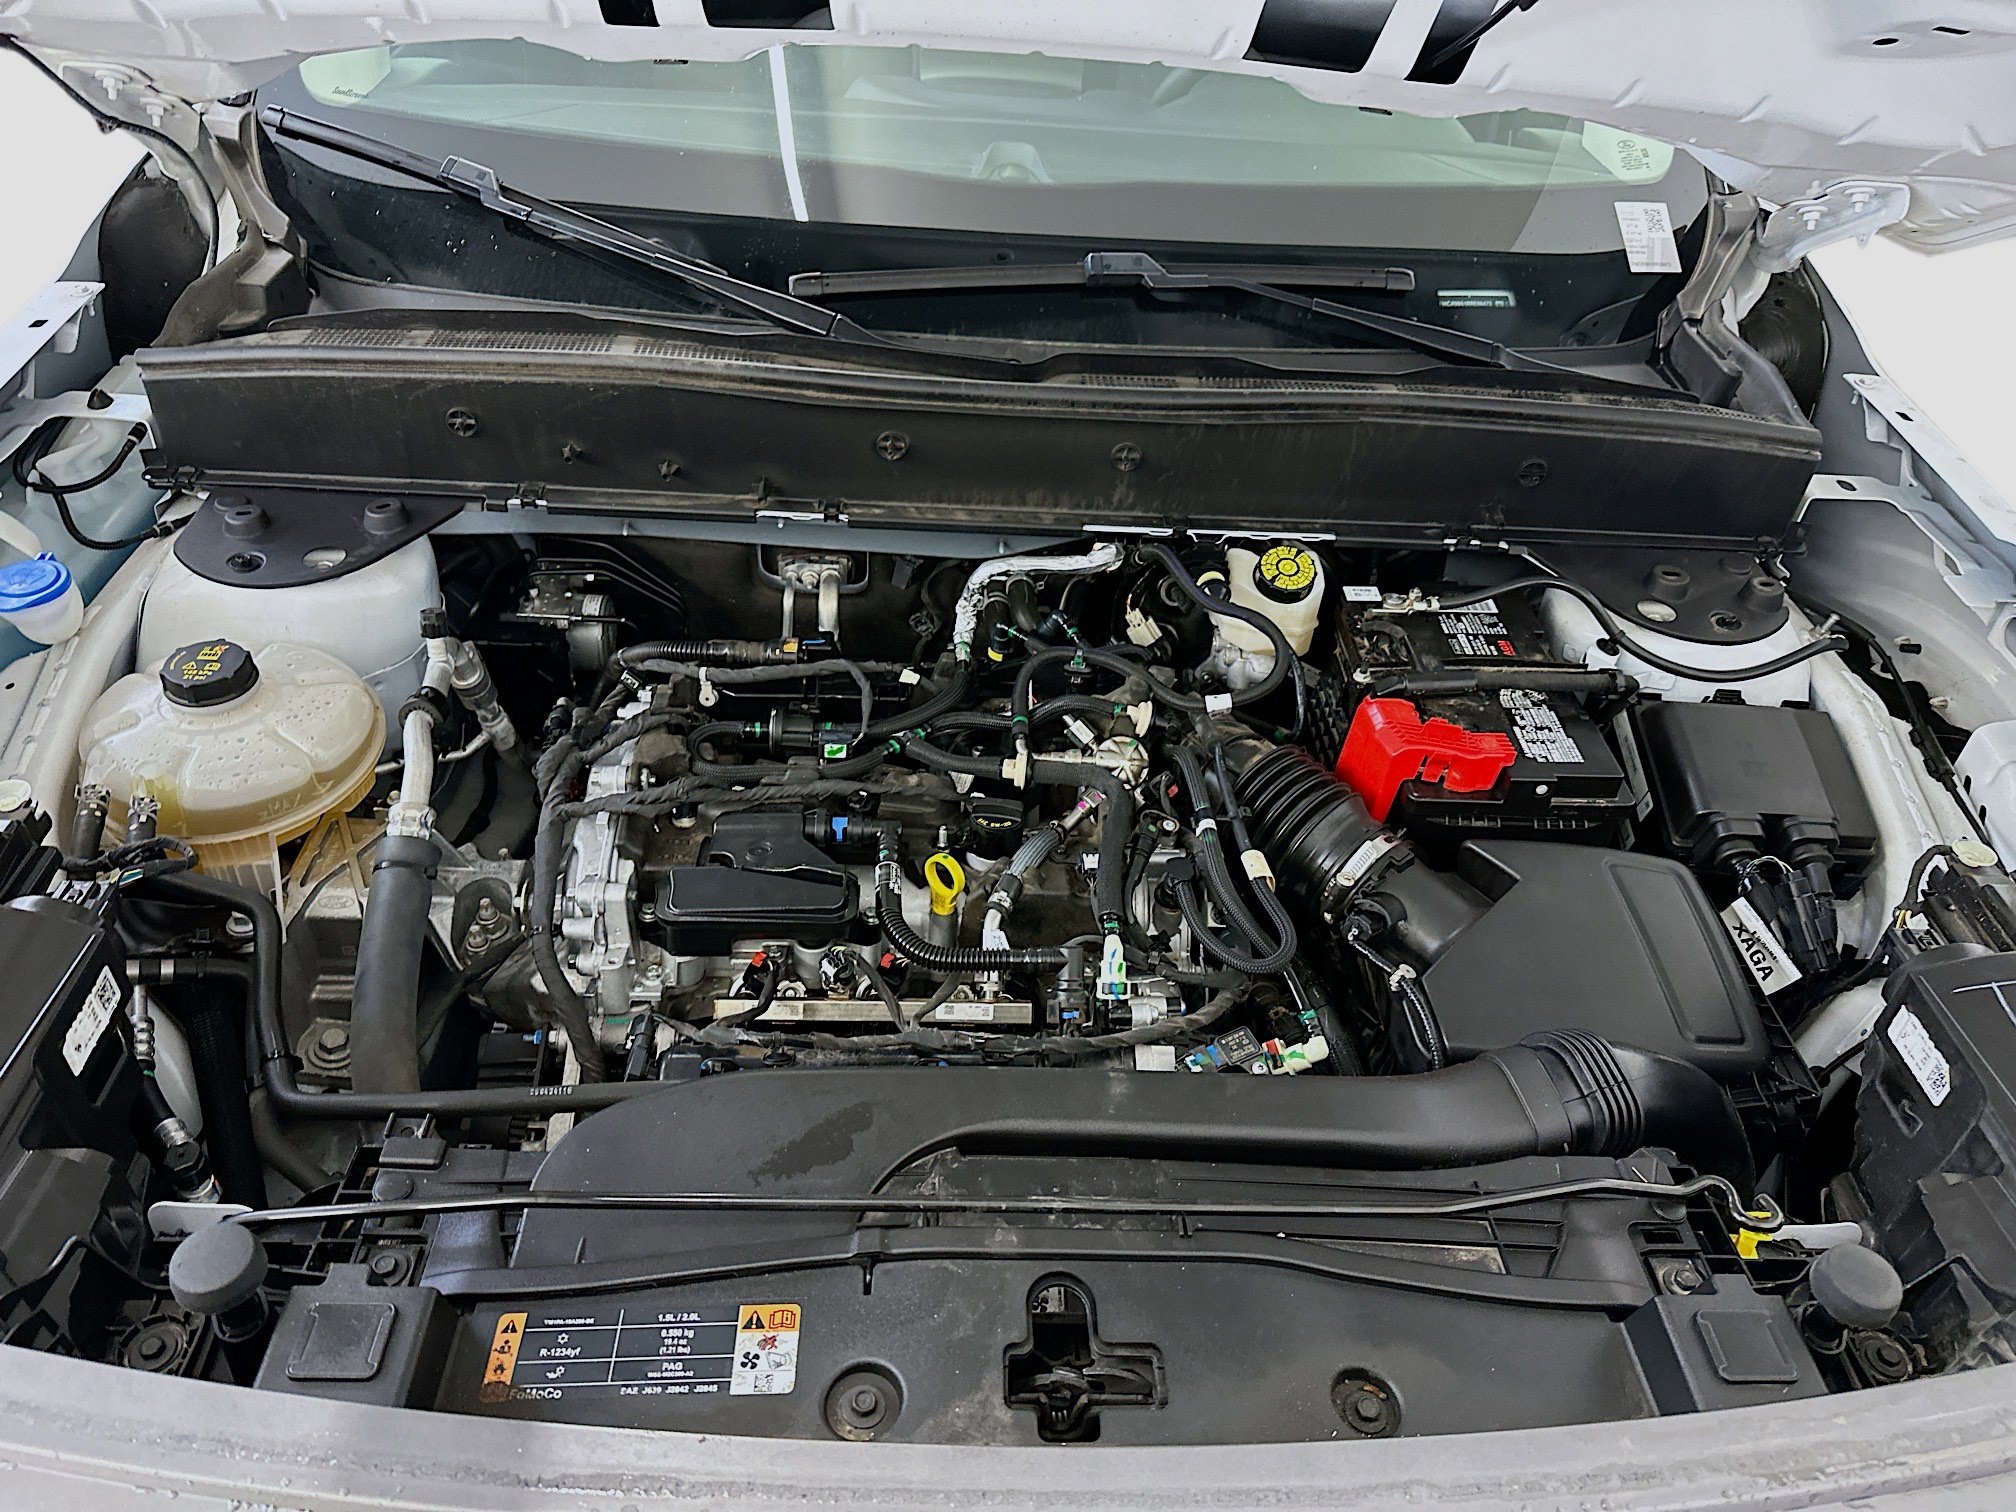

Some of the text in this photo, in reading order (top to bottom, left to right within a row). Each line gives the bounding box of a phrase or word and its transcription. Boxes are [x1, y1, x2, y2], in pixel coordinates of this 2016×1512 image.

[1732, 922, 1774, 981] XAGA
[540, 1347, 581, 1358] R-1234yf
[662, 1361, 683, 1371] PAG
[509, 1387, 563, 1399] FoMoCo
